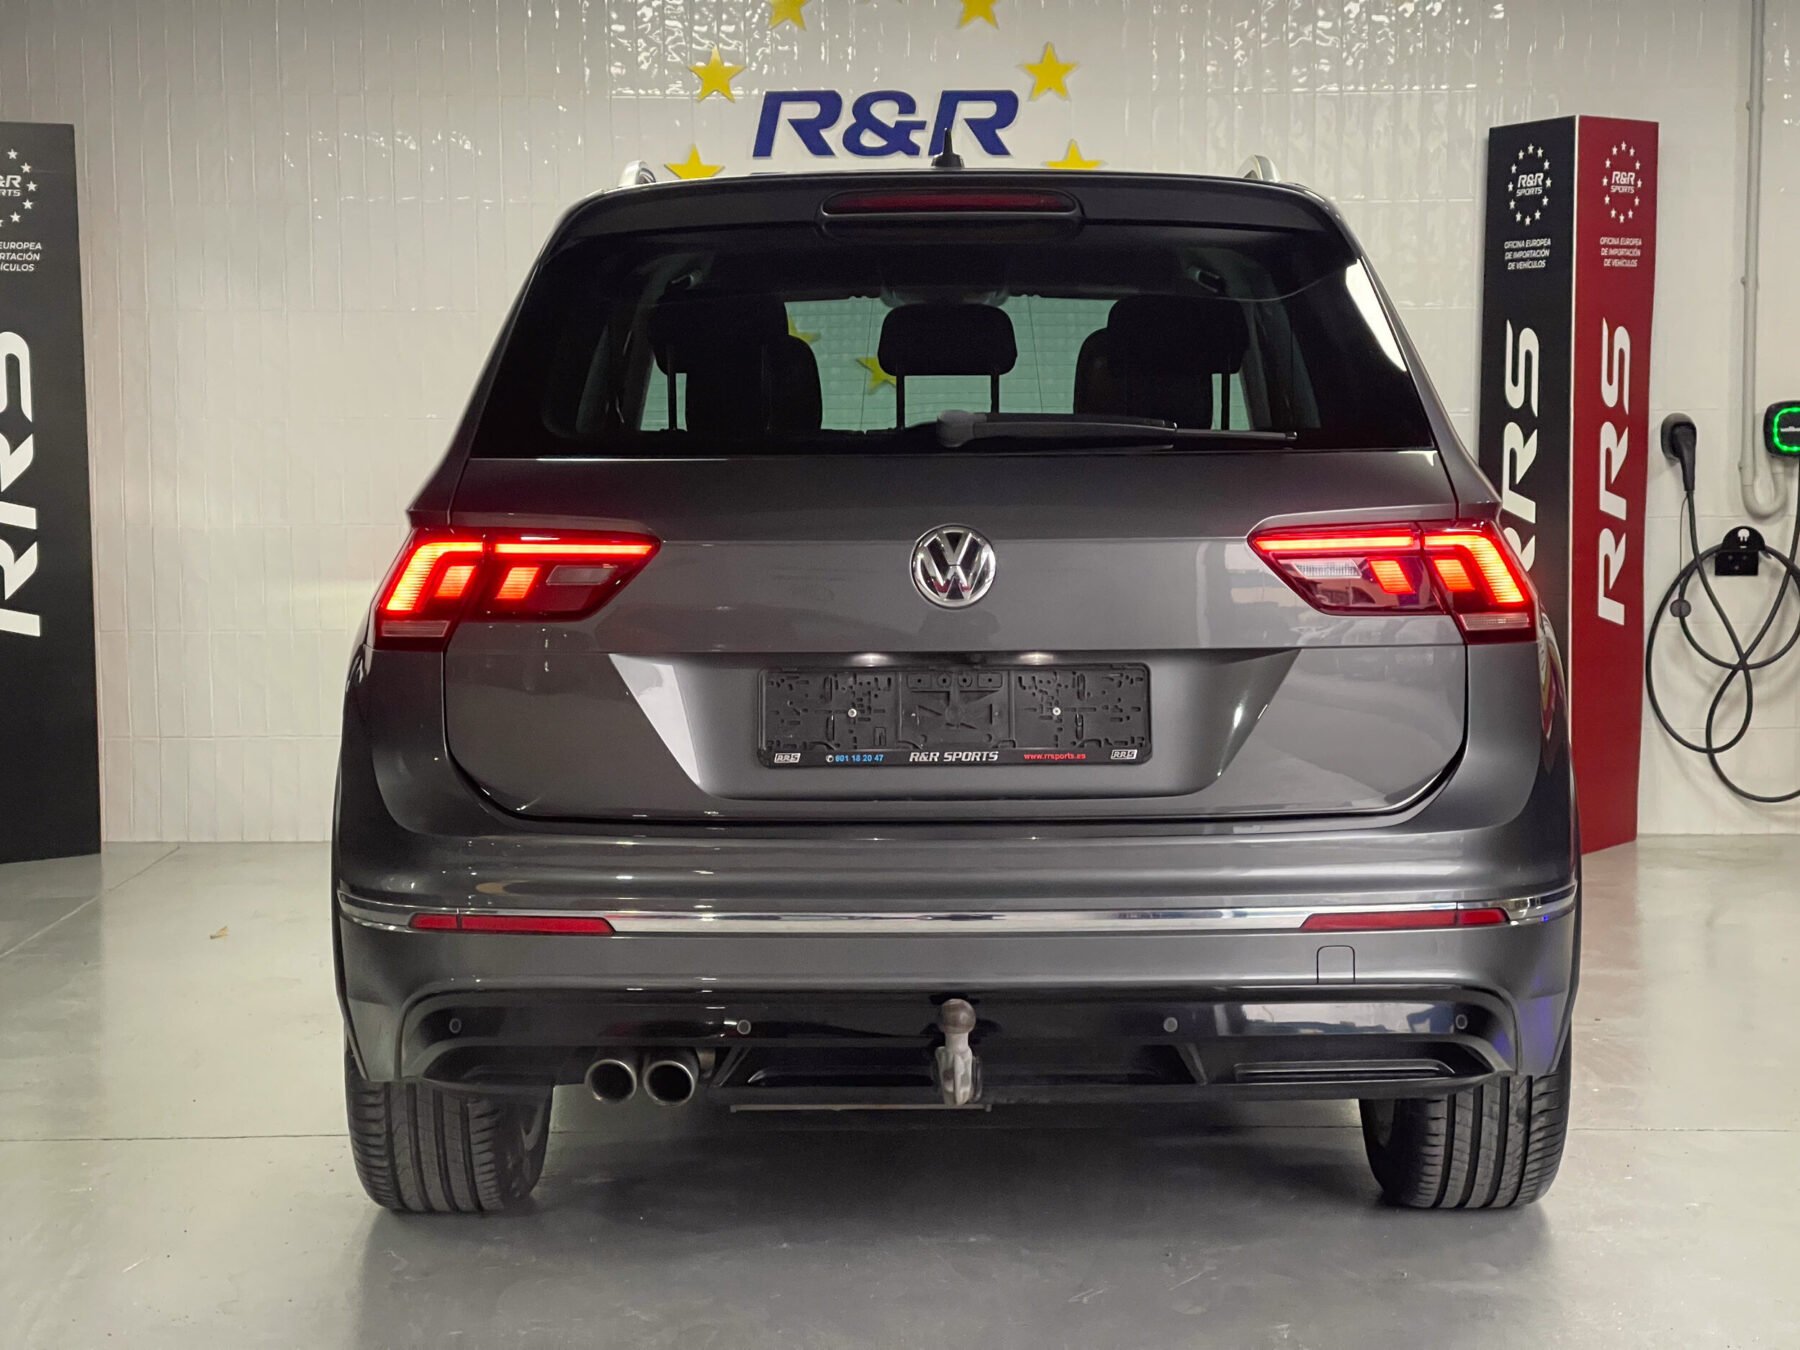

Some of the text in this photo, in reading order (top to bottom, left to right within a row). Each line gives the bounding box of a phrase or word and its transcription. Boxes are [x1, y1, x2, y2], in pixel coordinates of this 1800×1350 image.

[753, 89, 1019, 157] R&R
[1517, 172, 1544, 188] R&R
[1611, 171, 1635, 185] R&R
[1516, 186, 1543, 197] SPORTS
[1610, 185, 1635, 194] SPORTS
[1504, 237, 1551, 249] OFICINA EUROPEA
[1600, 236, 1642, 246] OFICINA EUROPEA
[1505, 248, 1550, 260] DE IMPORTACIÓN
[1601, 247, 1609, 256] DE
[1508, 262, 1516, 270] DE
[1603, 258, 1611, 267] DE
[1598, 317, 1631, 626] RRS
[863, 754, 872, 762] 20
[874, 754, 884, 762] 47
[909, 751, 999, 762] R&R SPORTS
[1111, 749, 1138, 760] RRS
